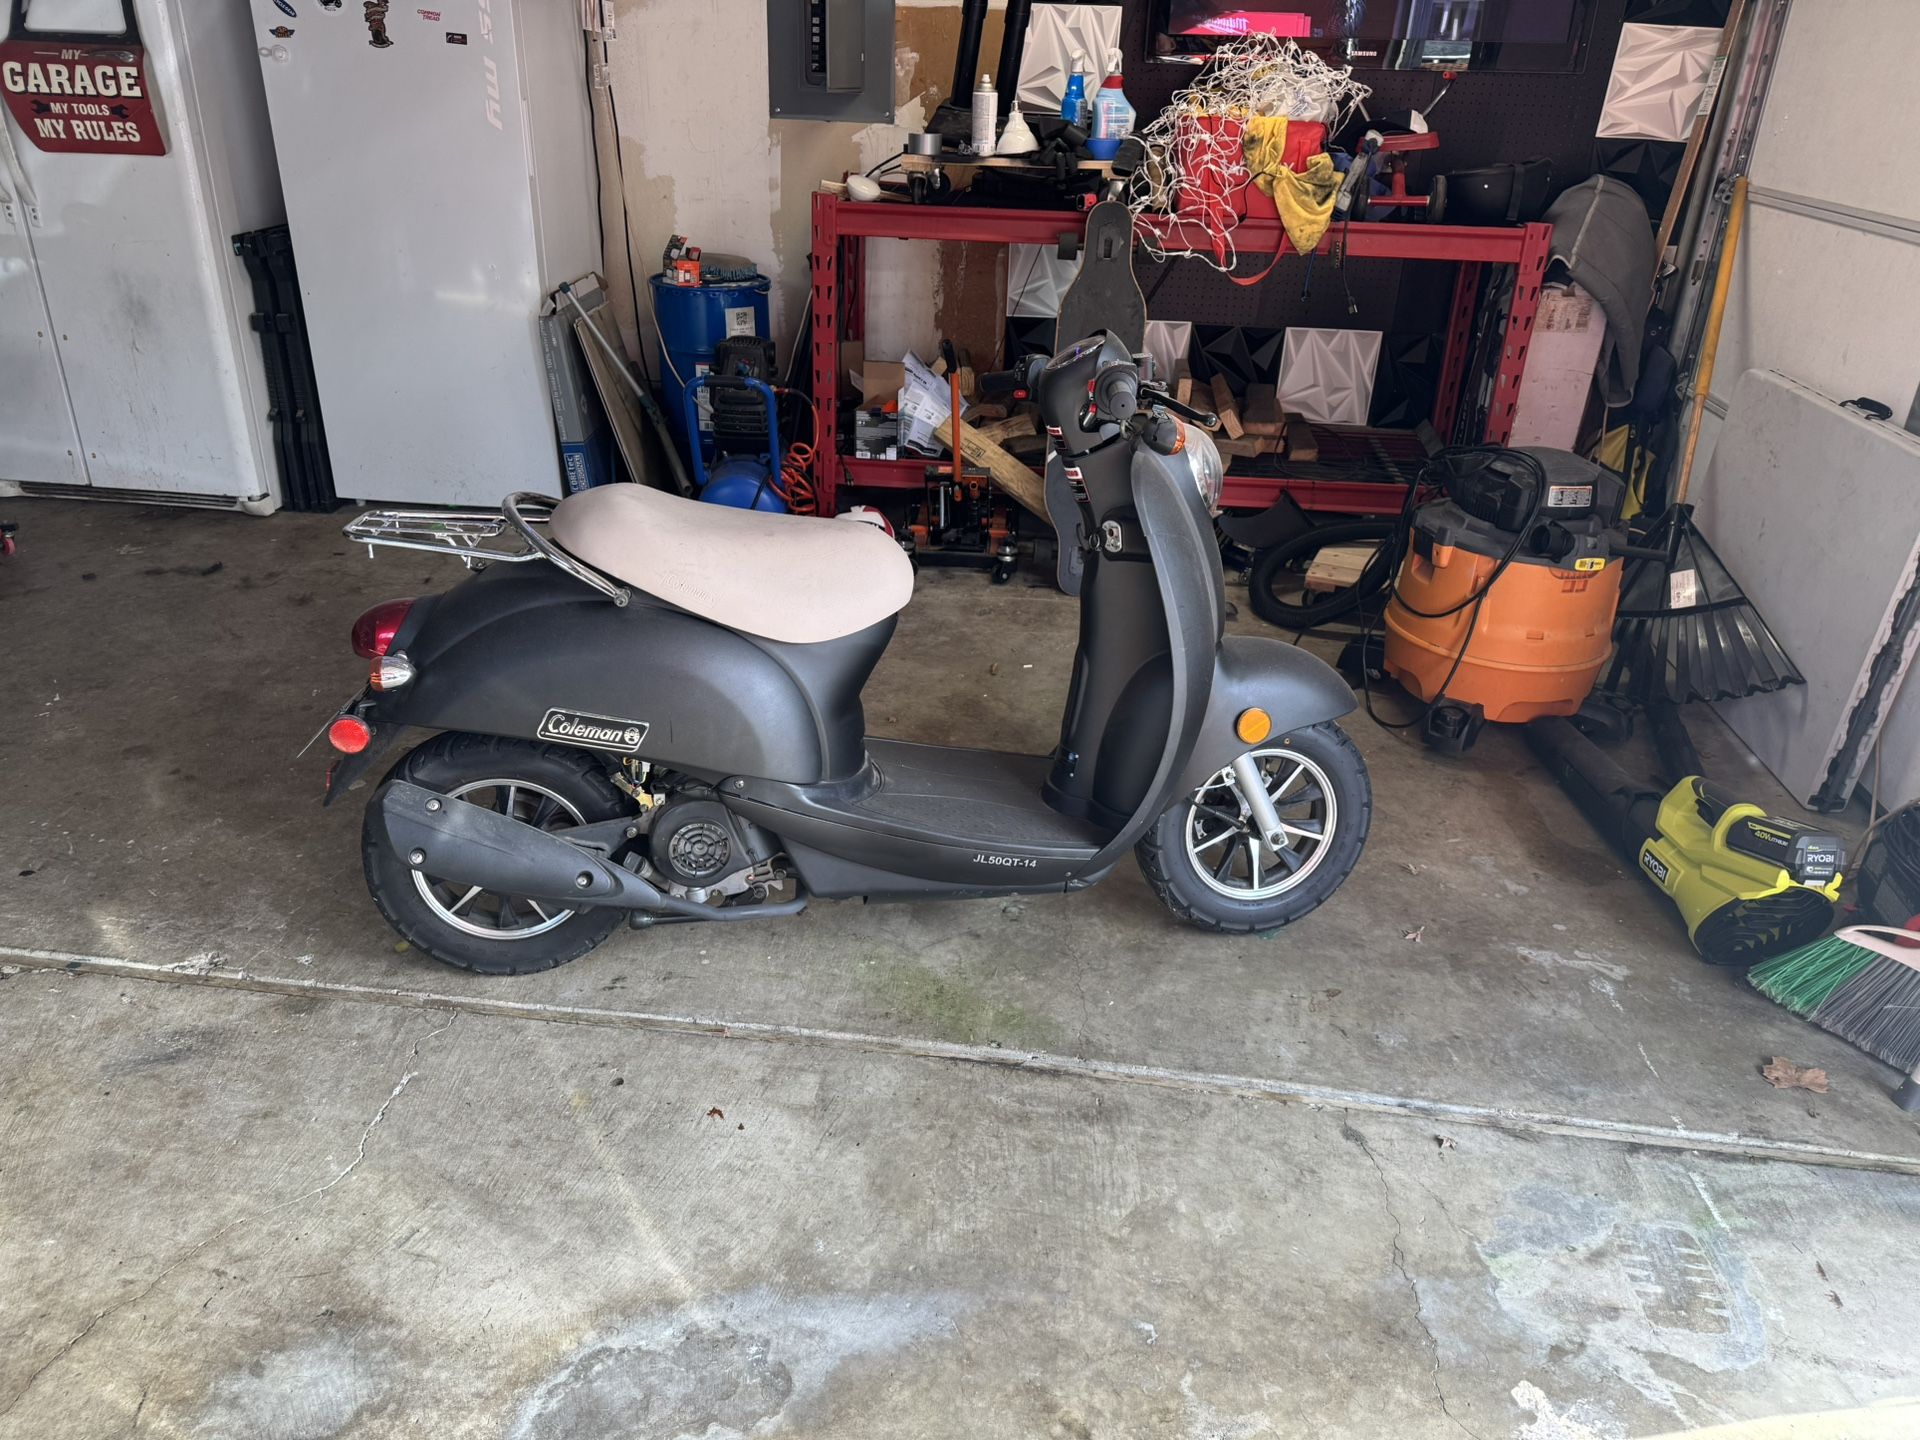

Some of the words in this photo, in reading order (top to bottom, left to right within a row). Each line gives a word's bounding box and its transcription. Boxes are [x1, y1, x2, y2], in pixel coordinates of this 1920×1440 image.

[417, 9, 440, 17] COMMON
[61, 49, 81, 60] MY
[2, 61, 143, 98] GARAGE
[50, 102, 69, 115] MY
[71, 103, 111, 116] TOOLS
[34, 118, 67, 139] MY
[70, 119, 141, 143] RULES
[548, 714, 623, 742] Coleman
[973, 854, 1037, 868] JL50QT-14
[1807, 854, 1835, 863] RYOBI
[1643, 852, 1667, 881] RYOBI
